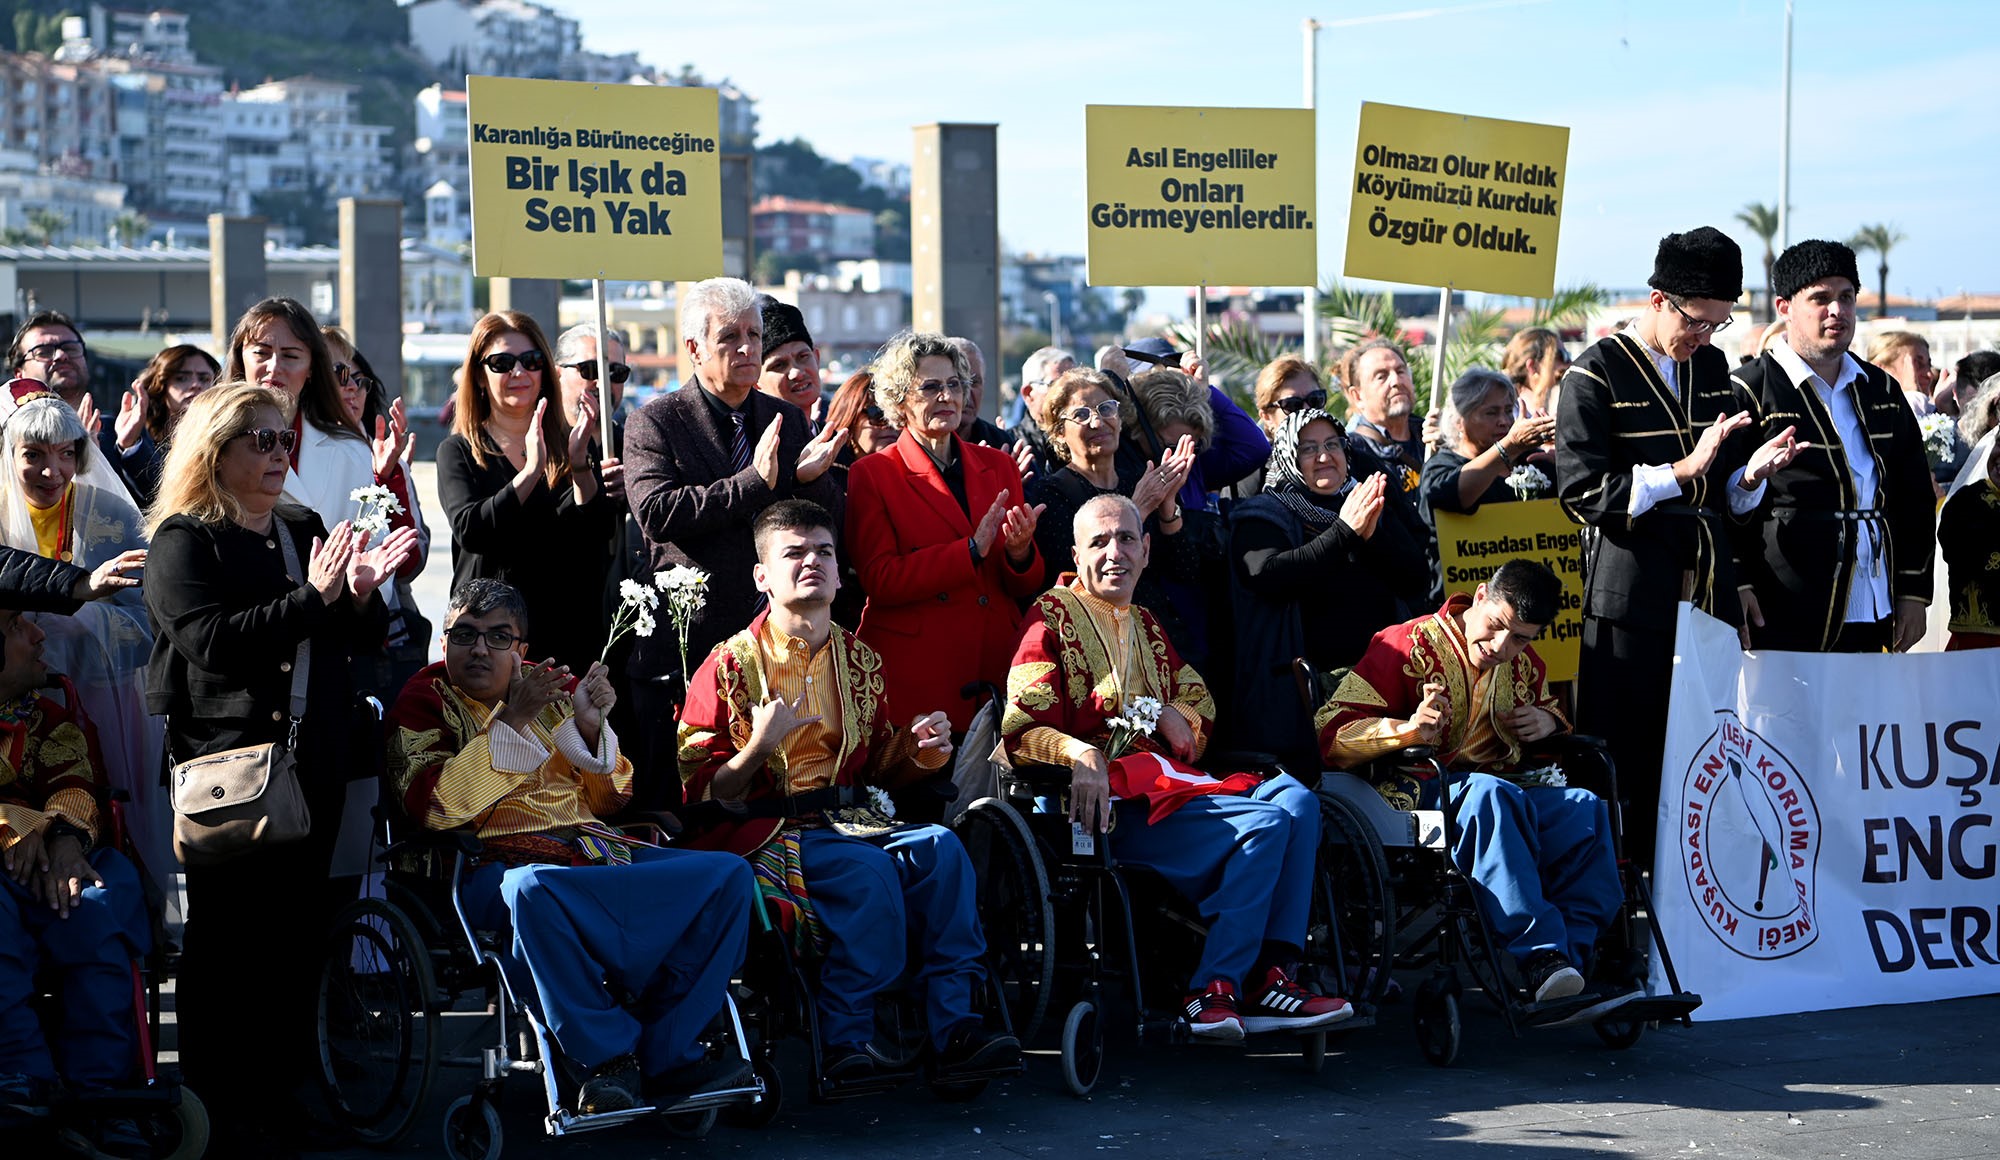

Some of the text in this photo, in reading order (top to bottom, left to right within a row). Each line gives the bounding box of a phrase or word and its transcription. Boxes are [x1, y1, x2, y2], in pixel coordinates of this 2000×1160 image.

[473, 123, 715, 155] Karanlığa Bürüneceğine
[1125, 147, 1278, 173] Asıl Engelliler
[506, 155, 687, 200] Bir Işık da
[1362, 144, 1558, 188] Olmazı Olur Kıldık
[1160, 177, 1244, 203] Onları
[1356, 172, 1558, 217] Köyümüzü Kurduk
[525, 197, 672, 236] Sen Yak
[1091, 202, 1314, 234] Görmeyenlerdir.
[1368, 205, 1538, 255] Özgür Olduk.
[1456, 535, 1533, 558] Kuşadası
[1859, 720, 2000, 808] KUŞ
[1687, 801, 1739, 936] KUŞADASI
[1756, 754, 1809, 869] KORUMA
[1862, 813, 1997, 883] ENG
[1862, 905, 2000, 973] DER
